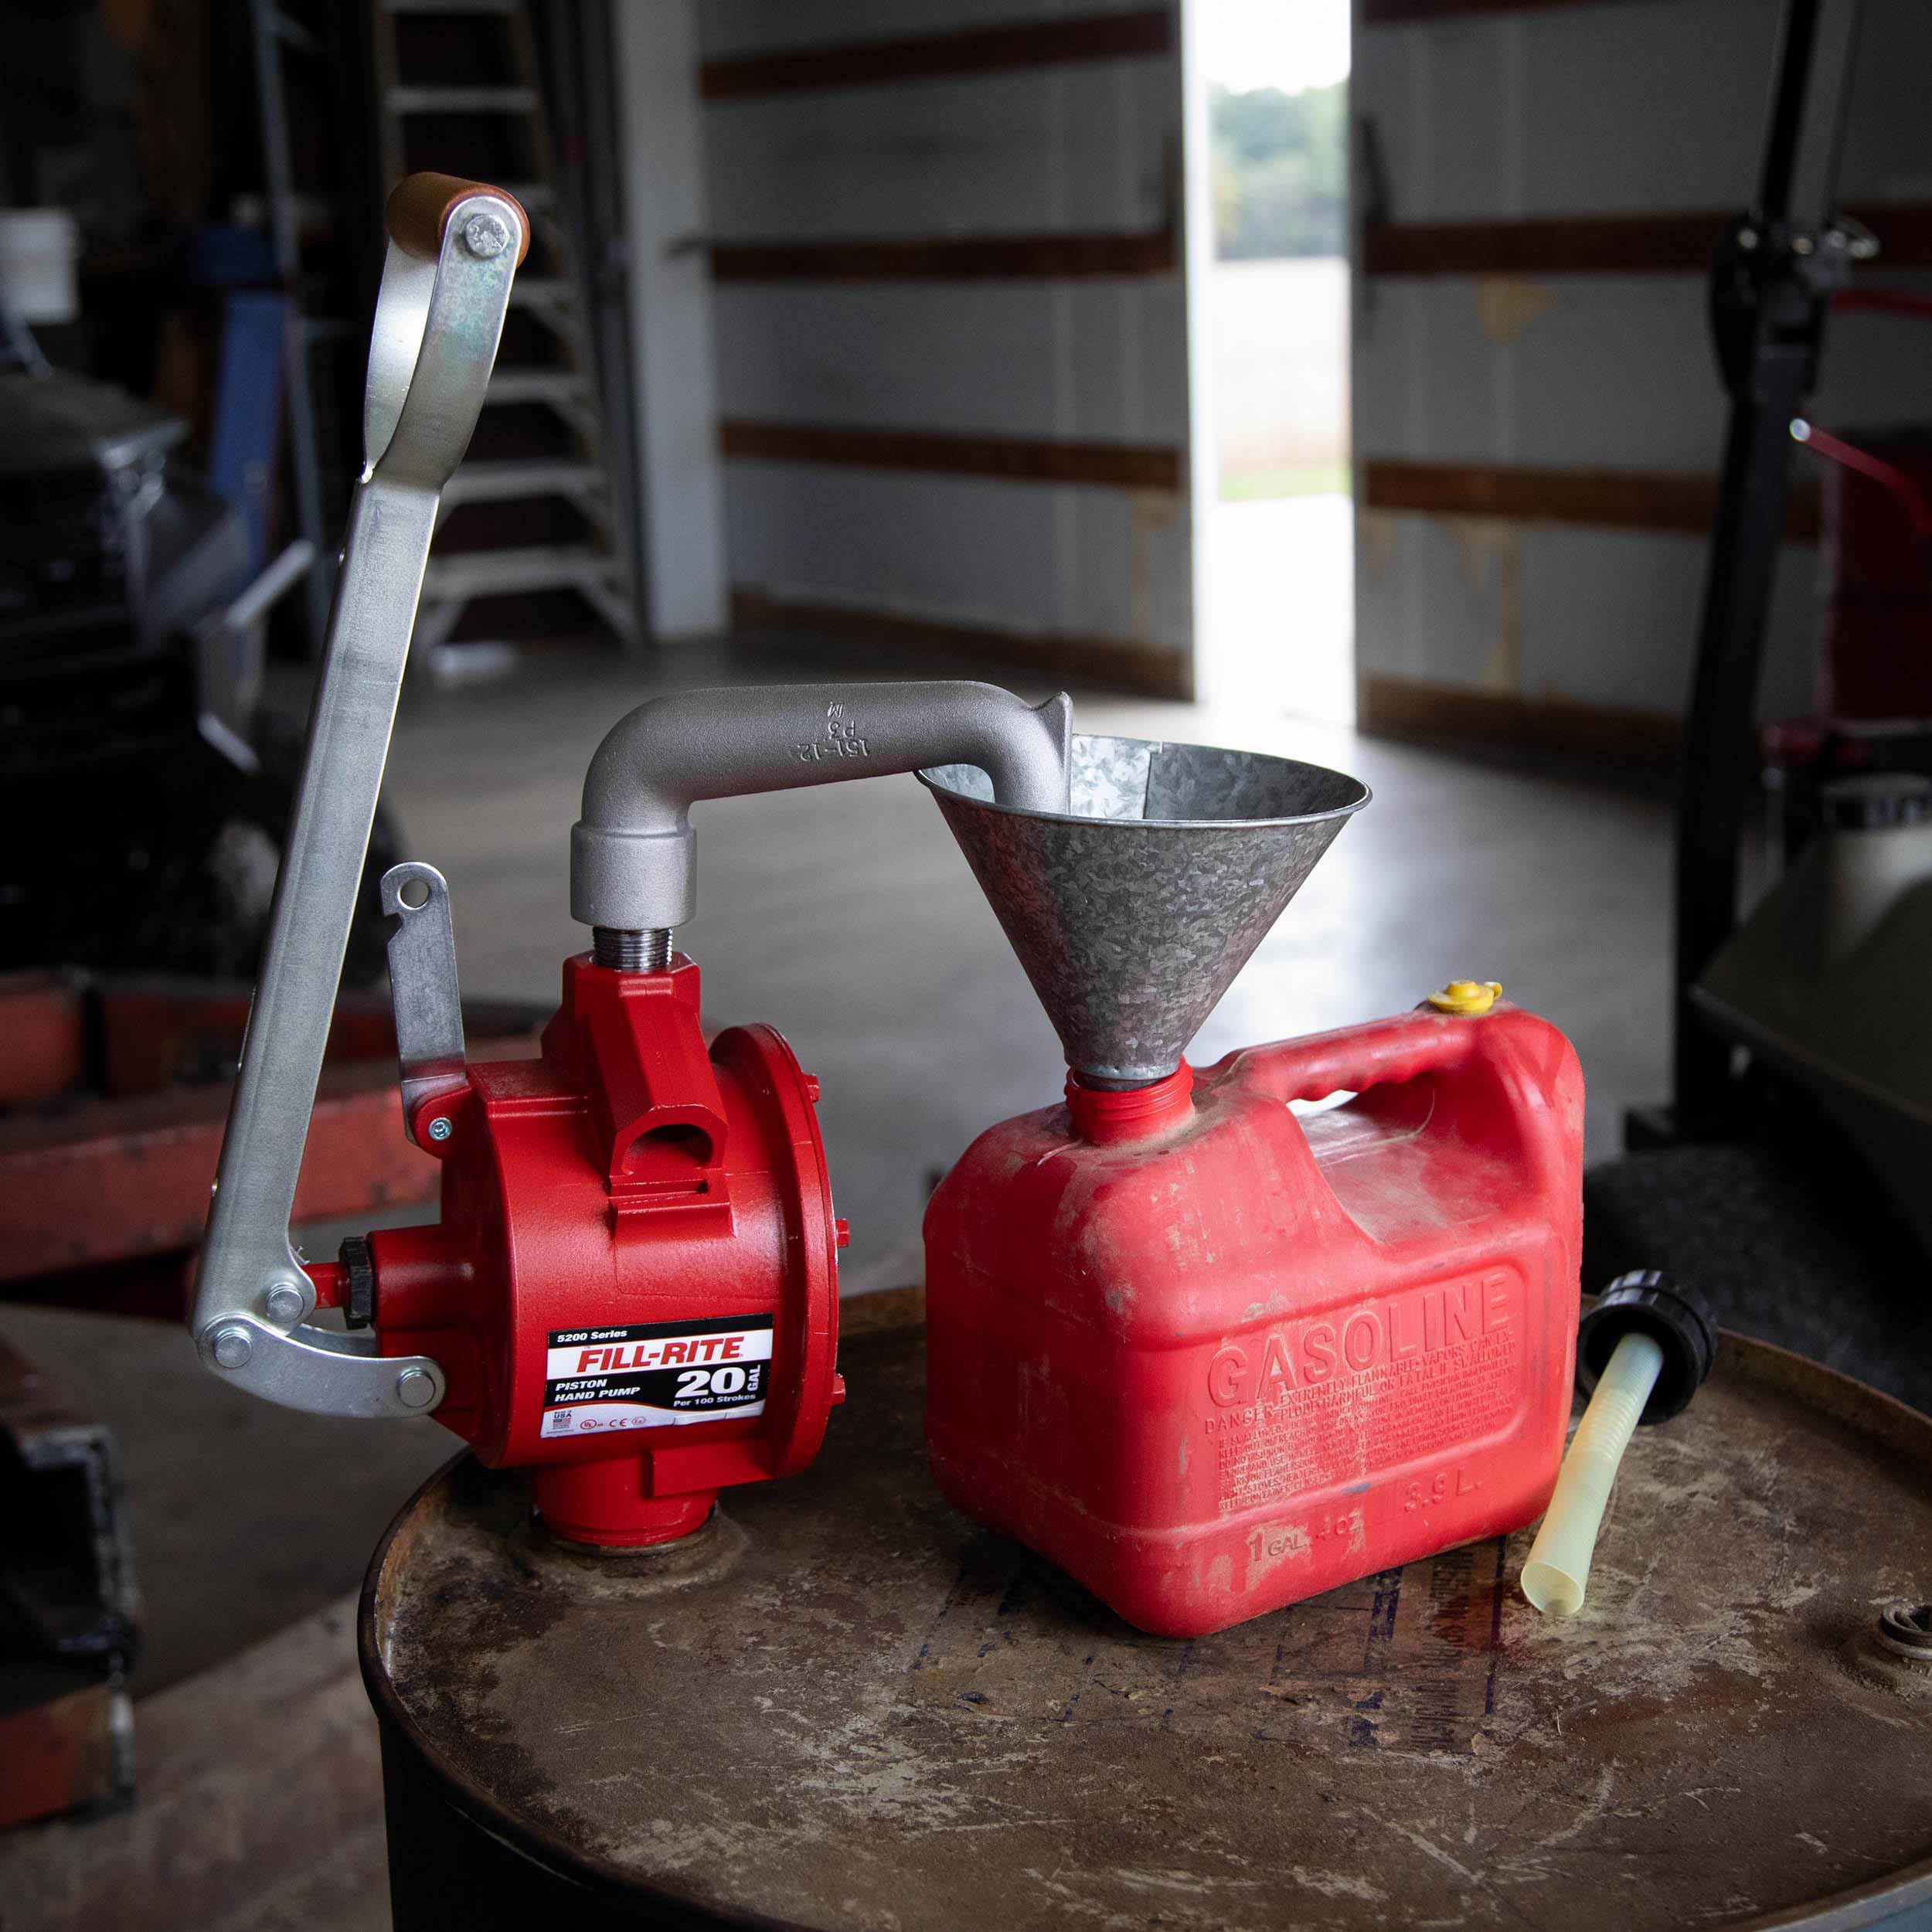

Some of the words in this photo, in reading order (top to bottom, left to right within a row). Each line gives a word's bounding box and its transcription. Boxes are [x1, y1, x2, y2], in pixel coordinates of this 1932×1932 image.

[797, 739, 871, 762] 151-12
[556, 1332, 587, 1343] 5200
[590, 1329, 628, 1340] Series
[1207, 1271, 1511, 1408] GASOLINE
[577, 1336, 745, 1372] FILL-RITE
[555, 1378, 607, 1392] PISTON
[675, 1366, 746, 1399] 20
[747, 1364, 761, 1392] GAL
[554, 1390, 595, 1402] HAND
[599, 1386, 641, 1397] PUMP
[716, 1393, 757, 1403] Strokes
[1249, 1524, 1264, 1562] 1
